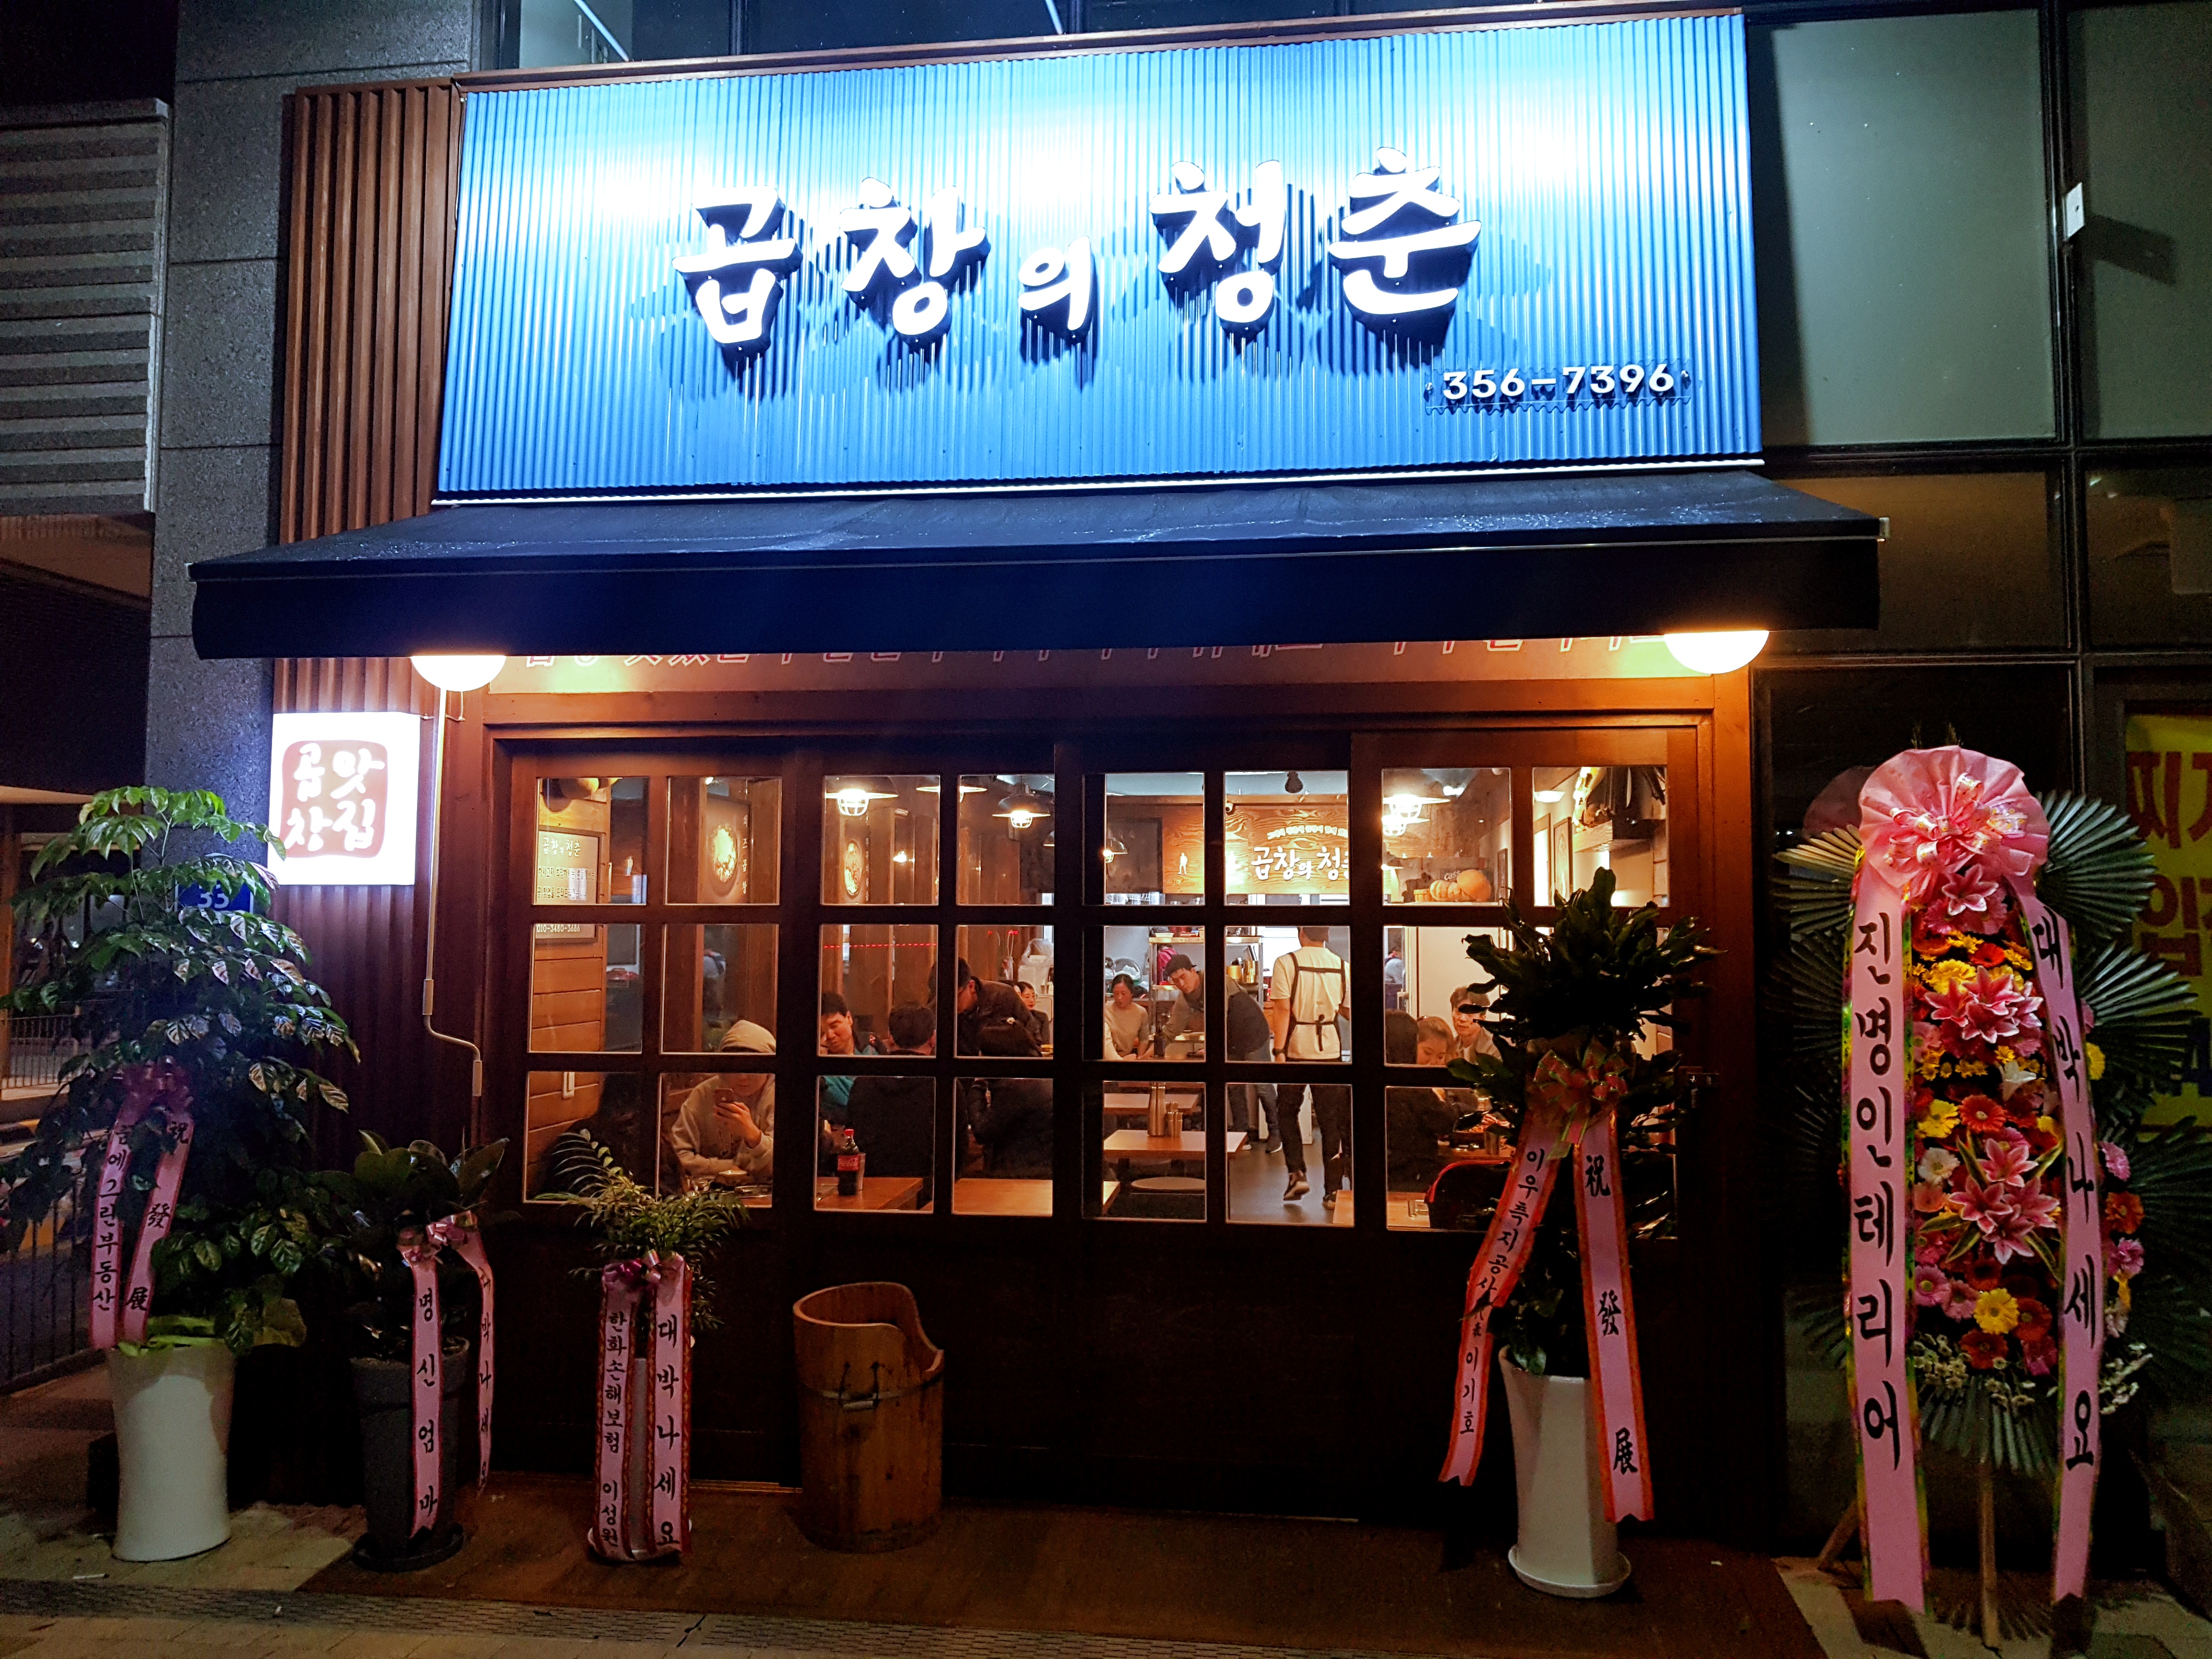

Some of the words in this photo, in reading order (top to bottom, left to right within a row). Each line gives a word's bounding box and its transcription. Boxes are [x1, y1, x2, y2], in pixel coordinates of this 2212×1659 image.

[672, 177, 1091, 344] 곱창의
[1149, 146, 1482, 323] 청춘
[1442, 363, 1675, 400] 356-7396
[331, 748, 385, 851] 맛집
[542, 836, 564, 856] 곱창의
[566, 839, 581, 857] 청춘
[1251, 846, 1311, 881] 곱창의
[1853, 912, 1901, 1471] 진명인테리어
[2032, 906, 2096, 1471] 대박나세요
[604, 1311, 628, 1454] 한화손해보험
[653, 1314, 680, 1547] 대박나세요
[1459, 1347, 1479, 1435] 이기호
